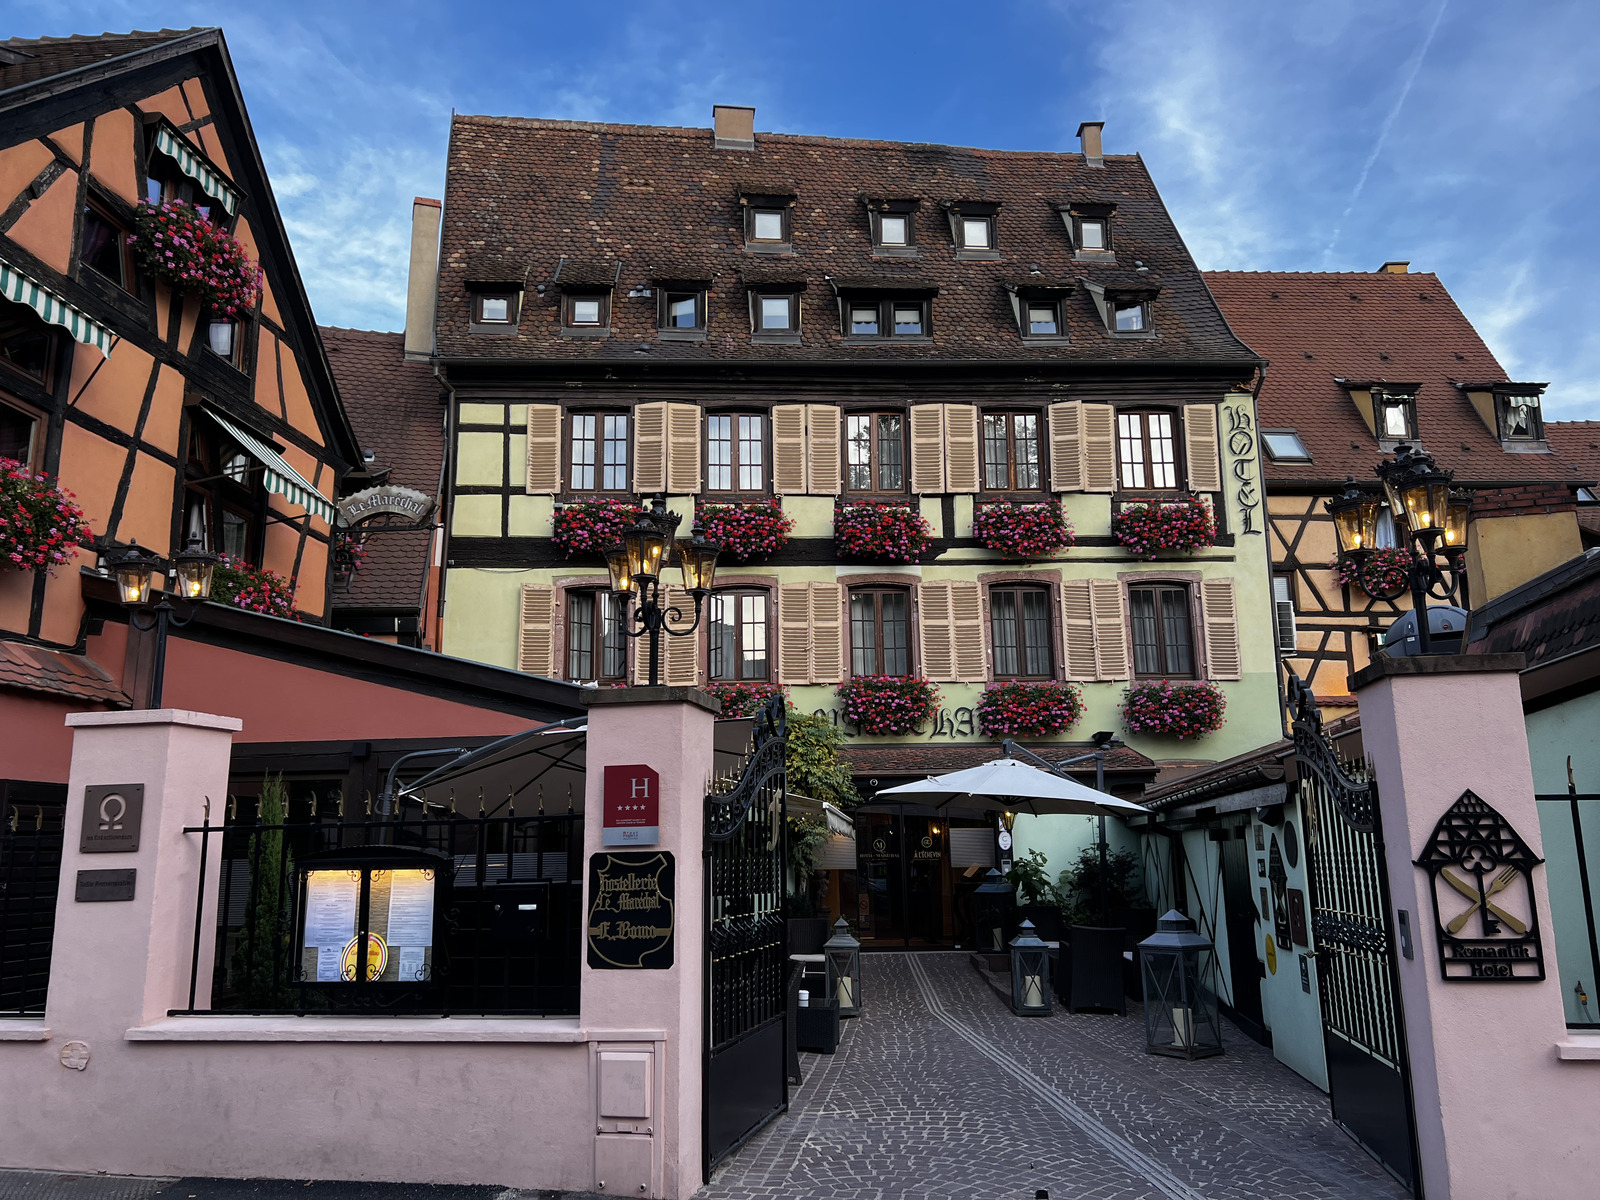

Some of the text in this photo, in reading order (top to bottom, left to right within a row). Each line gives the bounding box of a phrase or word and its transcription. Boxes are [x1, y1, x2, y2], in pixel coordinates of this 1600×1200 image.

[347, 493, 425, 516] Le Maréchal
[630, 777, 650, 799] H
[595, 893, 612, 911] Le
[1452, 944, 1530, 958] Romantik
[1471, 961, 1515, 977] Hotel
